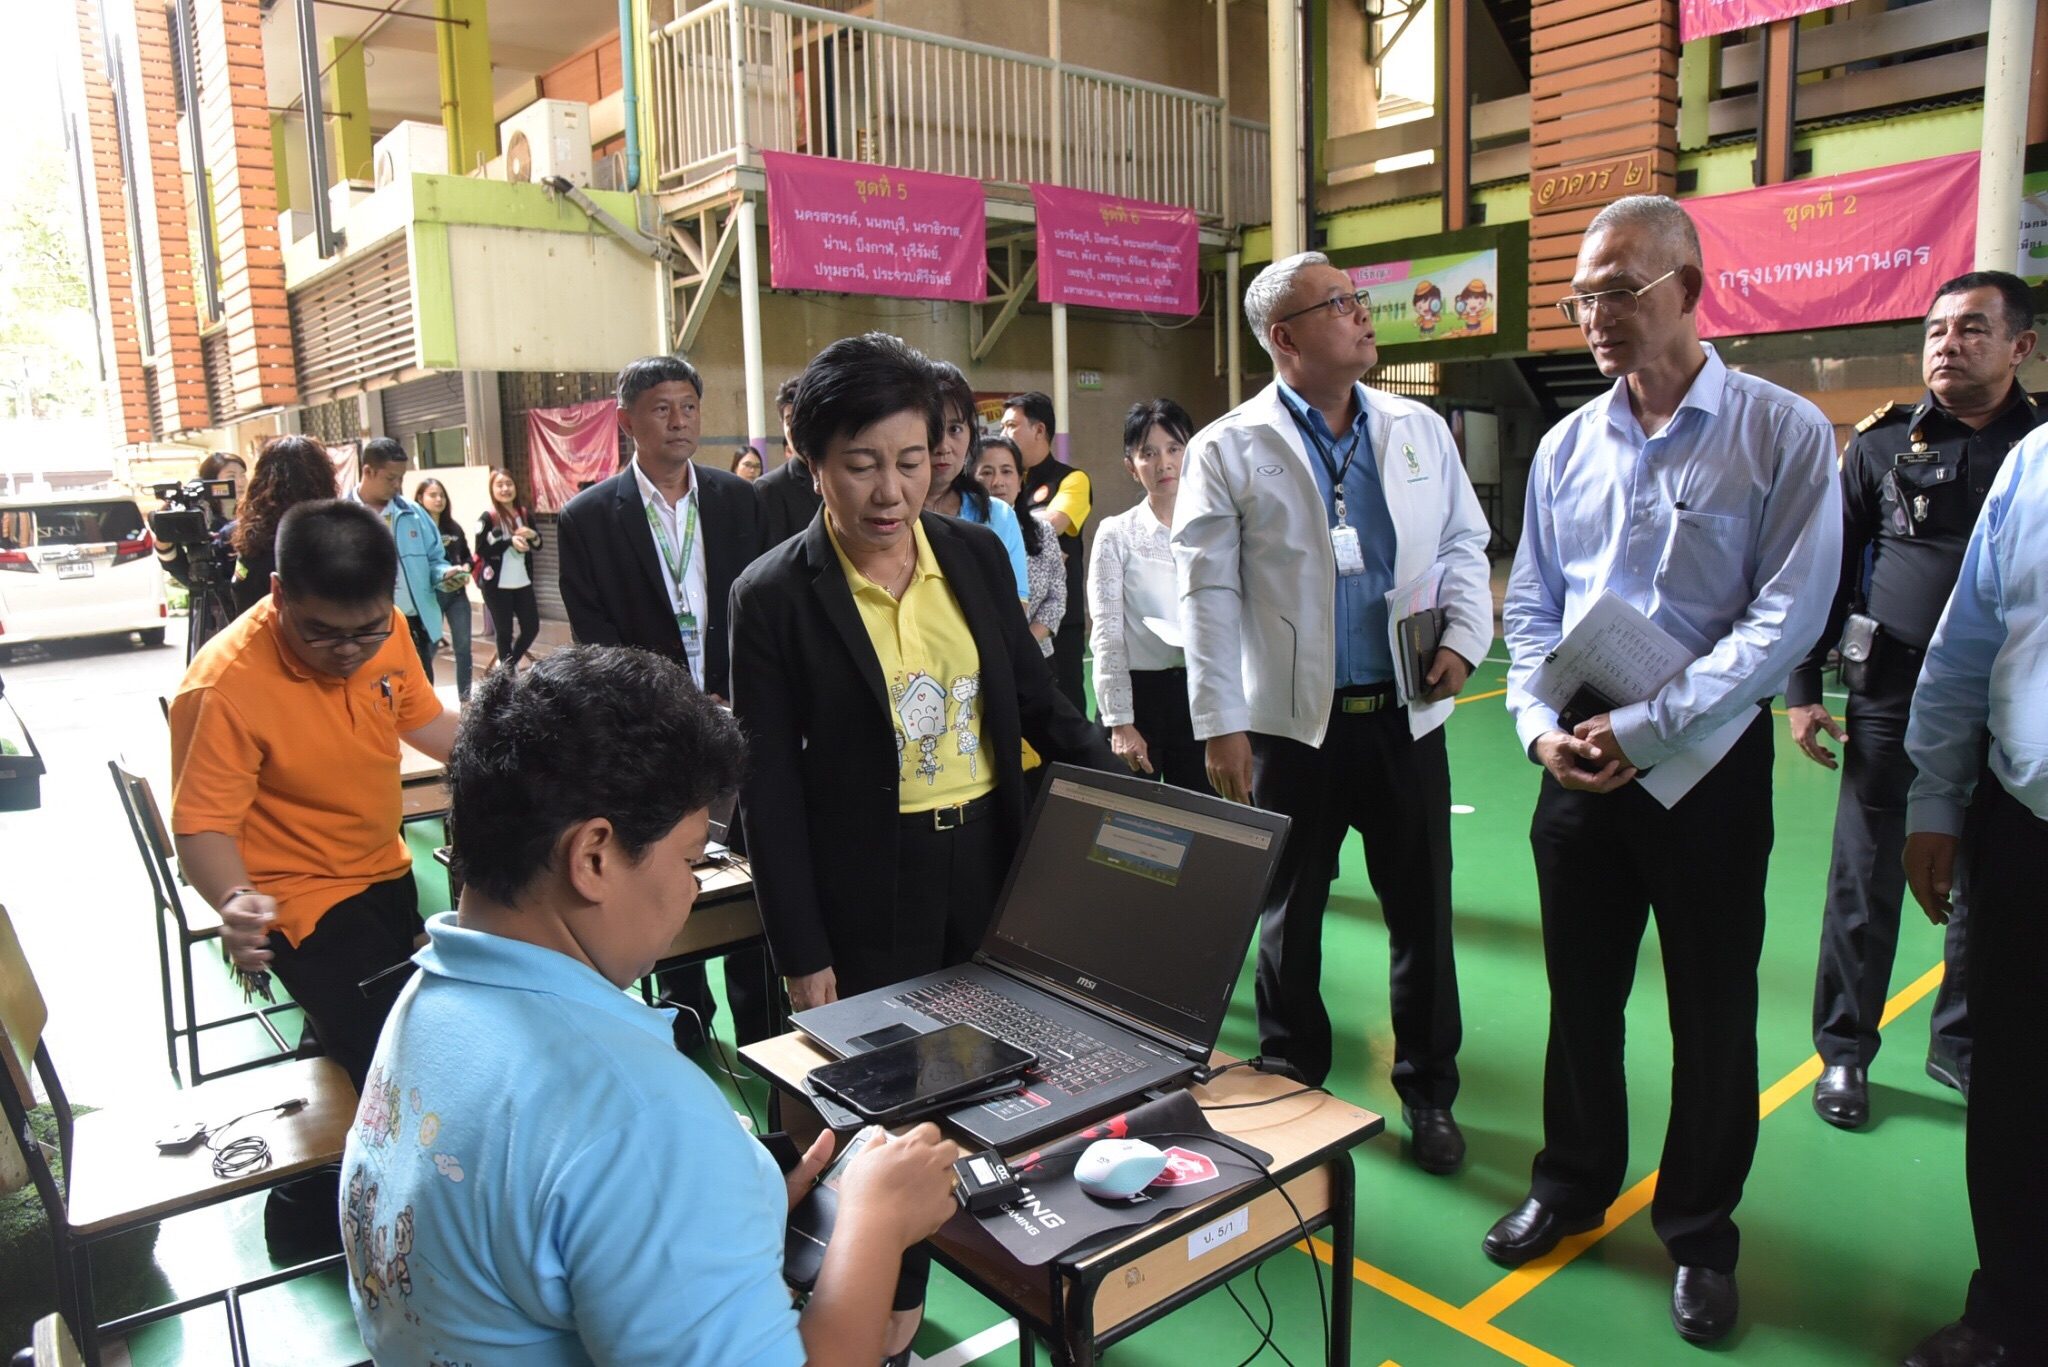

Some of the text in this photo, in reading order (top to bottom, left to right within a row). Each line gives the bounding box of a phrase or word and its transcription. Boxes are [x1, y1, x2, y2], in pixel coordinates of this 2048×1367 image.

[855, 174, 908, 204] ชุดที่ 5
[1537, 160, 1644, 205] อาคาร ๒
[794, 208, 862, 228] นครสวรรค์,
[865, 216, 910, 236] นนทบุรี,
[1783, 186, 1857, 232] ชุดที่ 2
[823, 233, 852, 252] น่าน,
[814, 262, 869, 282] ปทุมธานี,
[1718, 244, 1932, 297] กรุงเทพมหานคร
[1076, 976, 1098, 990] msi
[999, 1202, 1040, 1237] GAMING
[1204, 1222, 1233, 1244] ป. 5/1
